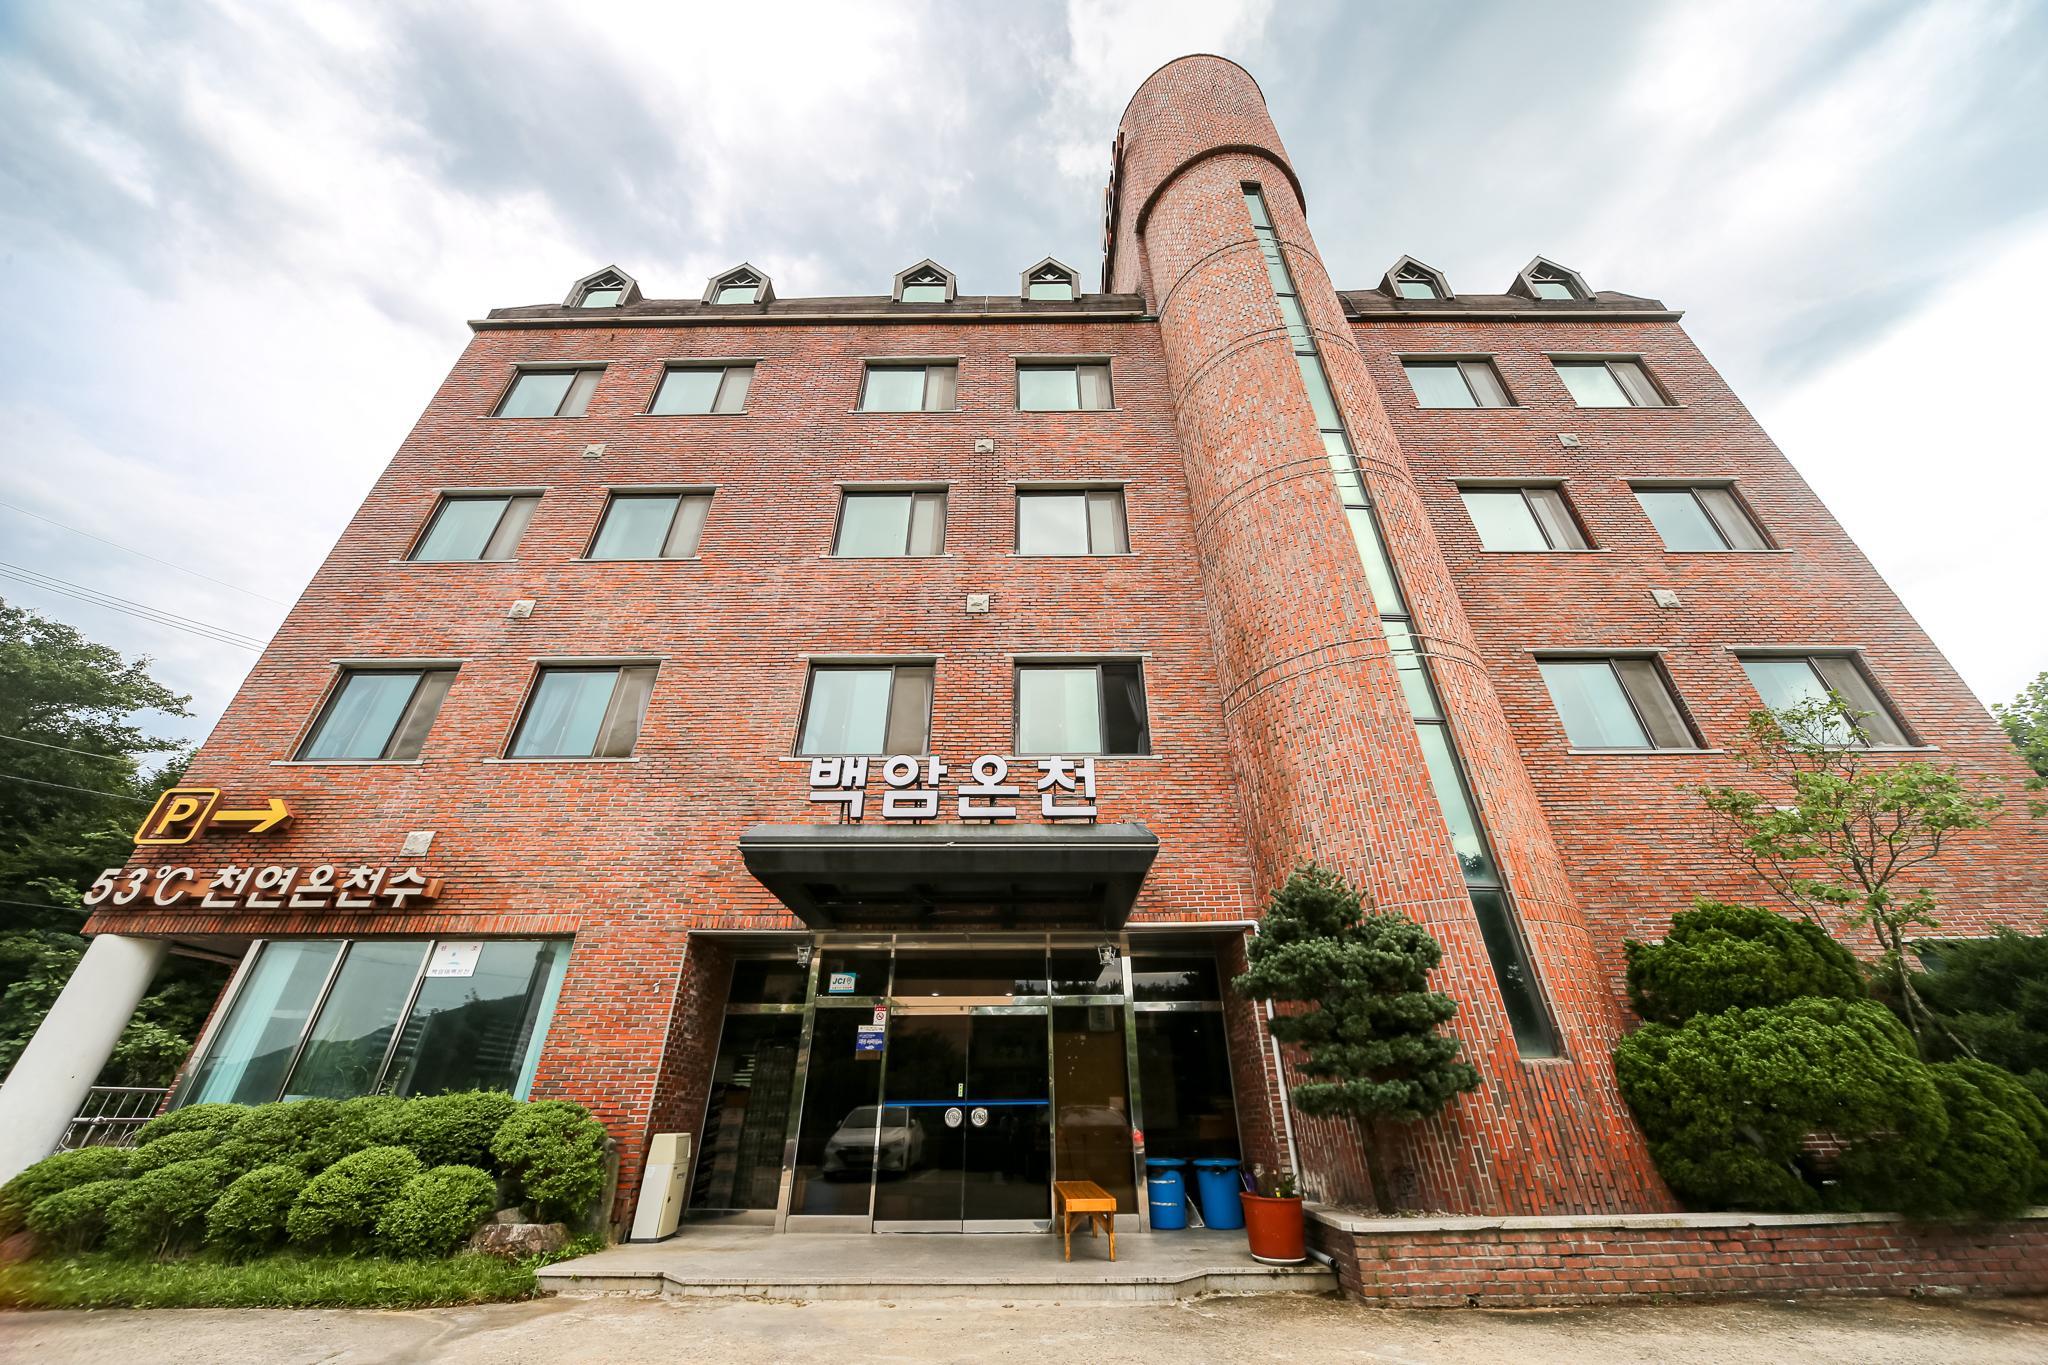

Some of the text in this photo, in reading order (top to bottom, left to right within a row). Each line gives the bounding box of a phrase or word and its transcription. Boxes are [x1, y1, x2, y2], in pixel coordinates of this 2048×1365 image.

[810, 755, 1097, 819] 백암온천
[155, 798, 199, 835] P
[200, 864, 427, 908] 천연온천수
[832, 977, 846, 985] JCI
